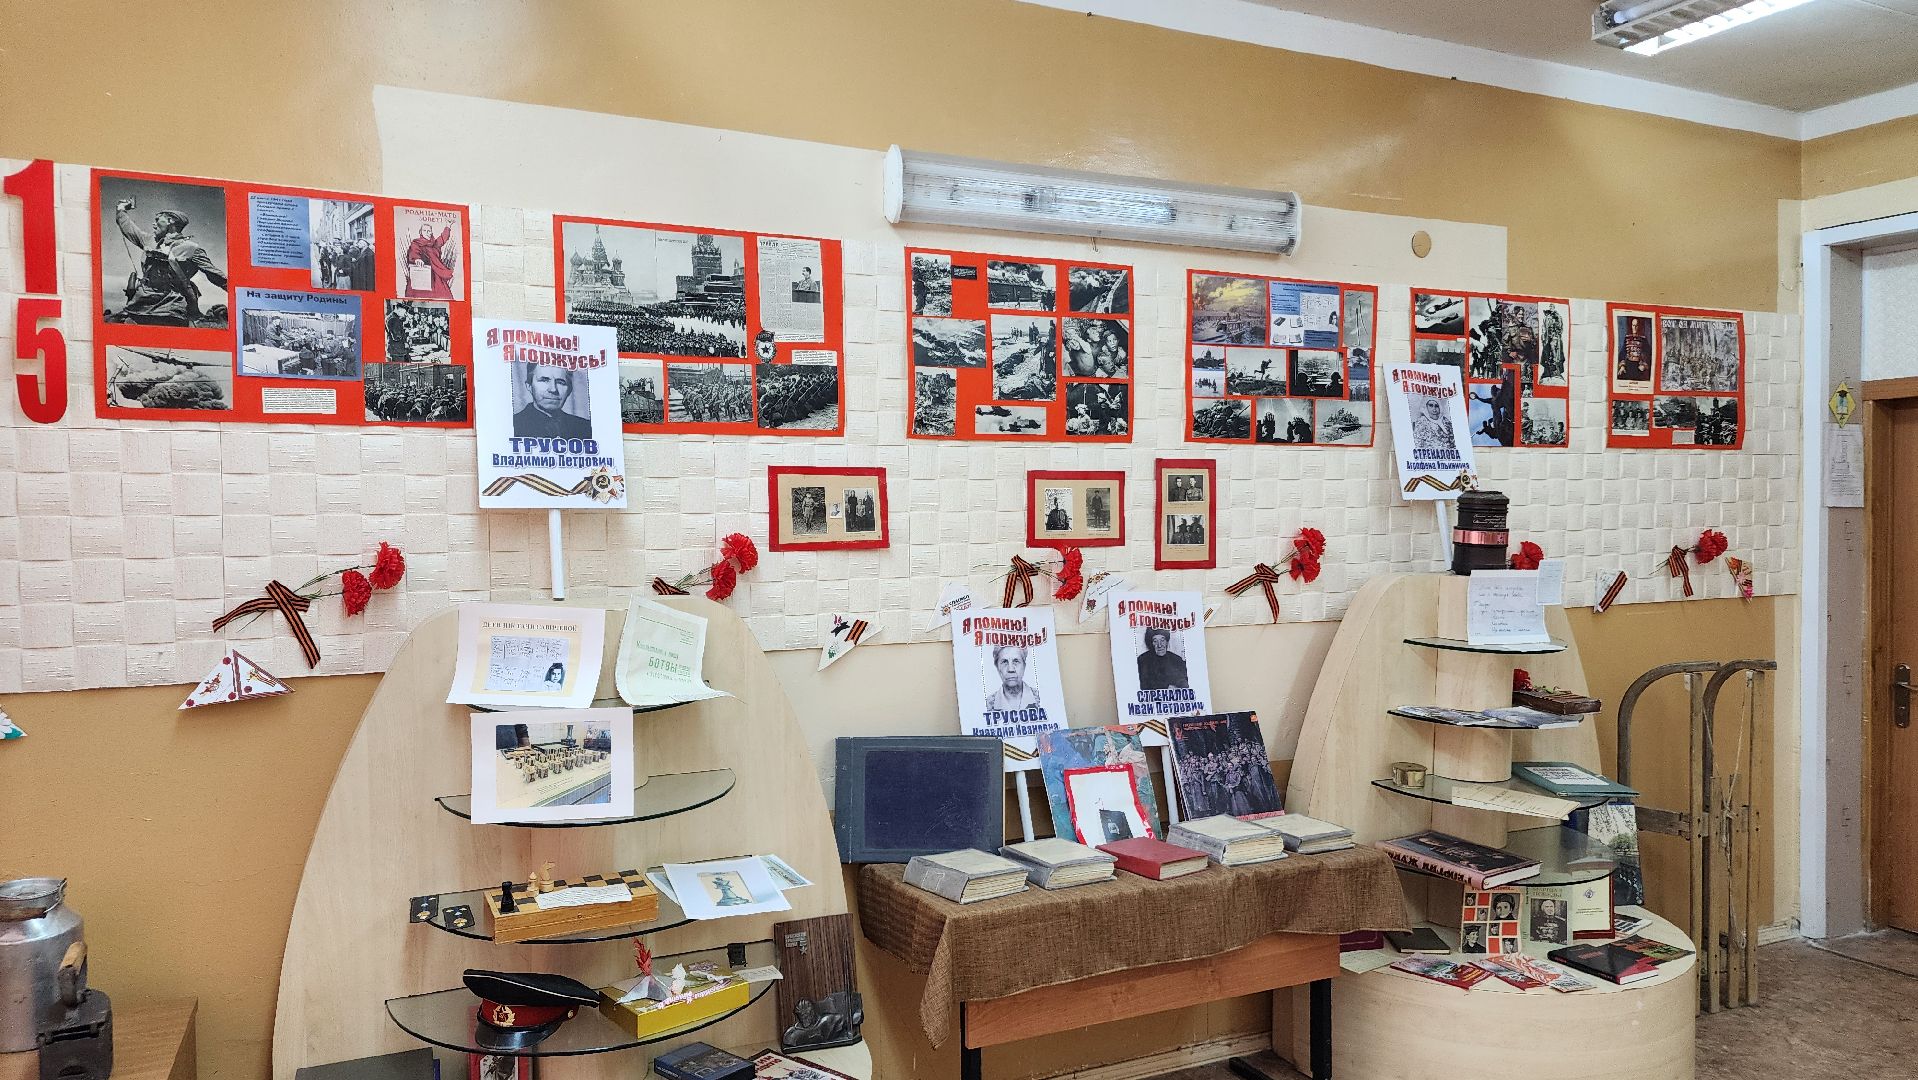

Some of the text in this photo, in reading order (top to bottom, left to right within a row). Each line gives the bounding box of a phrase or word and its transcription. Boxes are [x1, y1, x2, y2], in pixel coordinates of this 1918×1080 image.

[4, 159, 57, 294] 1
[246, 290, 348, 305] На защиту Родины
[486, 327, 579, 351] Я помню!
[16, 298, 67, 424] 5
[503, 344, 607, 371] Я горжусь!
[1392, 369, 1441, 385] Я помню!
[1402, 380, 1457, 399] Я горжусь!
[508, 437, 599, 455] ТРУСОВ
[1412, 448, 1461, 460] СТРЕКАЛОВА
[492, 453, 614, 469] Владимир Петрович
[1118, 599, 1178, 616] Я помню!
[962, 616, 1028, 635] Я помню!
[1129, 611, 1197, 632] Я горжусь!
[974, 626, 1048, 649] Я горжусь!
[1136, 688, 1196, 703] СТРЕКАЛОВ
[983, 707, 1048, 726] ТРУСОВА
[1127, 701, 1205, 716] Иван Петрович
